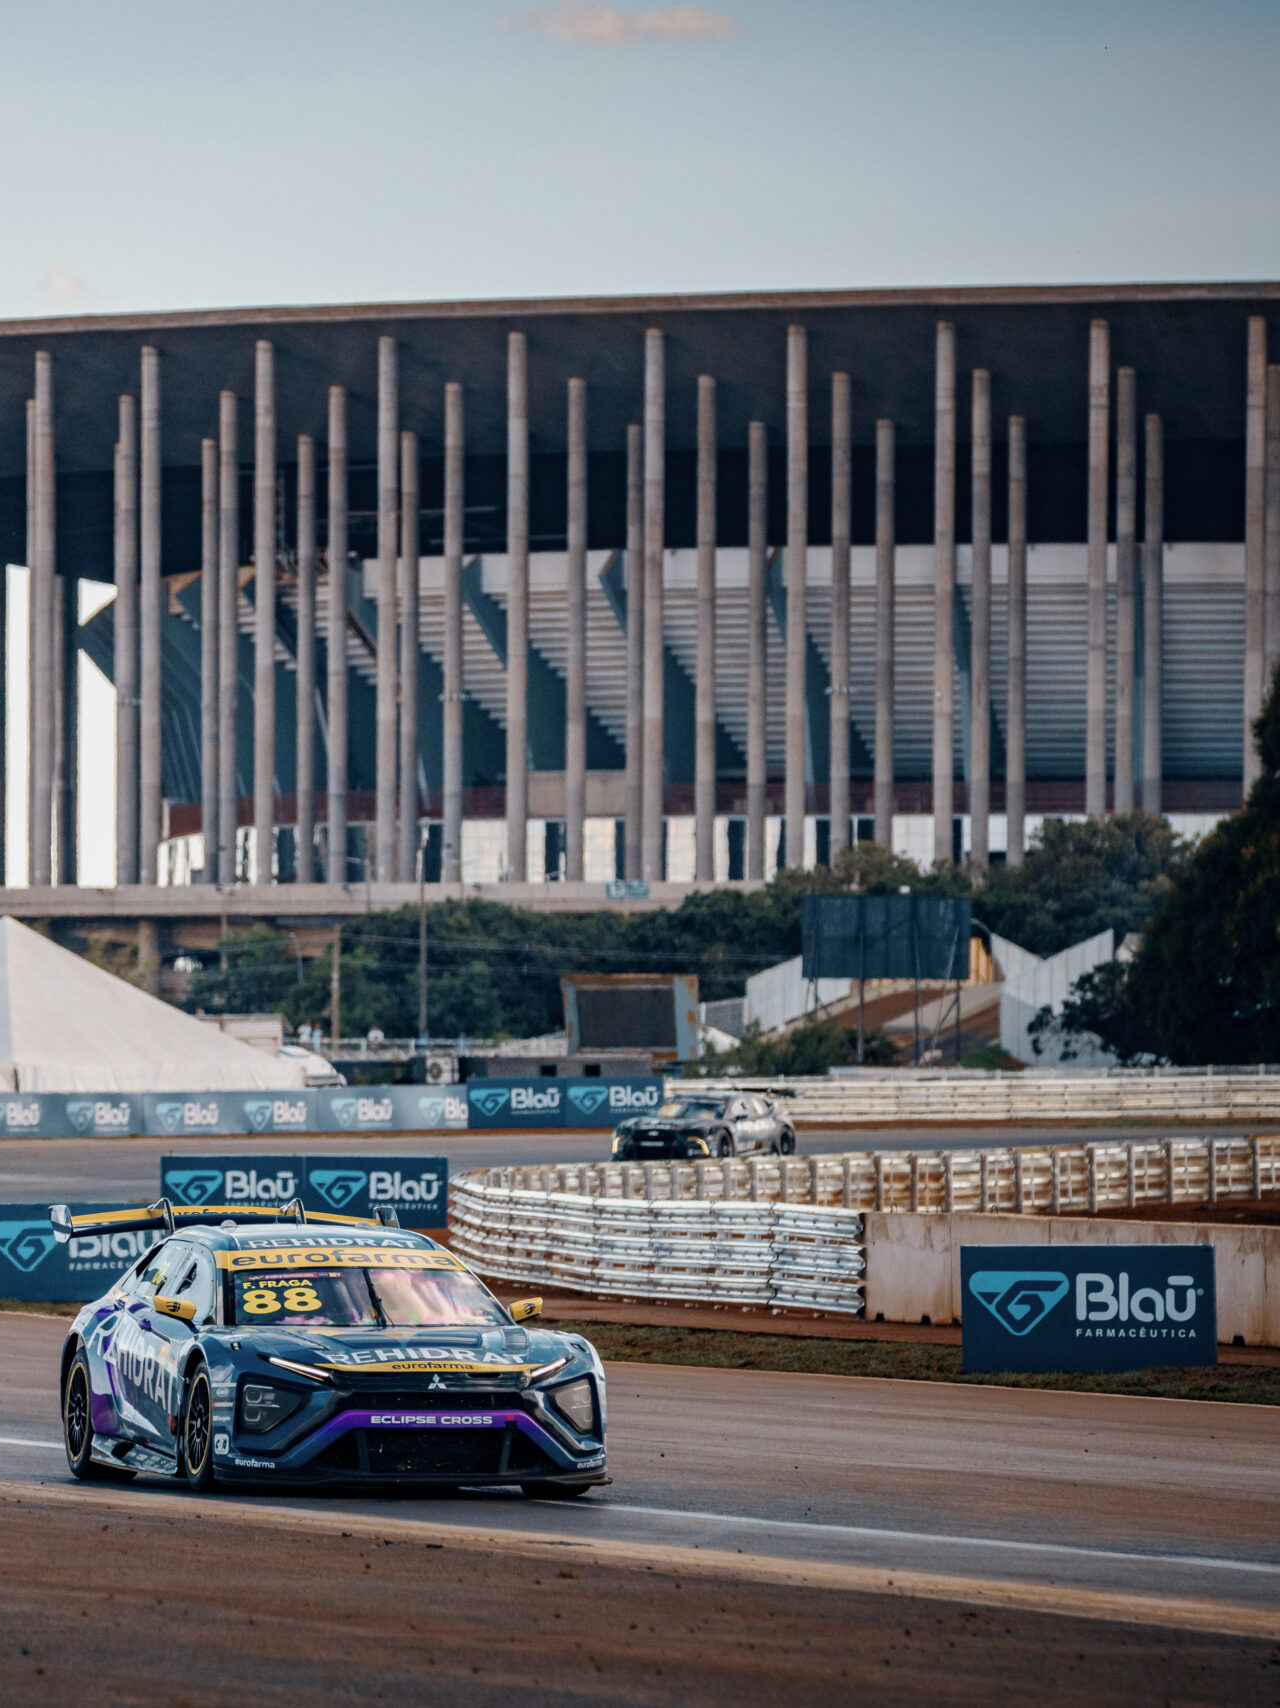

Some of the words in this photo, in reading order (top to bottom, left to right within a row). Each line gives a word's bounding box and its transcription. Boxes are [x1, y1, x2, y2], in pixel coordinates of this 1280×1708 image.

[246, 1237, 418, 1249] REHIDRAT
[231, 1249, 457, 1267] eurofarma
[243, 1281, 256, 1289] F.
[260, 1279, 313, 1289] FRAGA
[243, 1287, 322, 1314] 88
[1076, 1327, 1197, 1338] FARMACÊUTICA
[327, 1347, 527, 1365] REHIDRAT
[391, 1361, 475, 1370] eurofarma
[370, 1415, 437, 1424] ECLIPSE
[440, 1416, 493, 1425] CROSS
[234, 1457, 276, 1469] eurofarma
